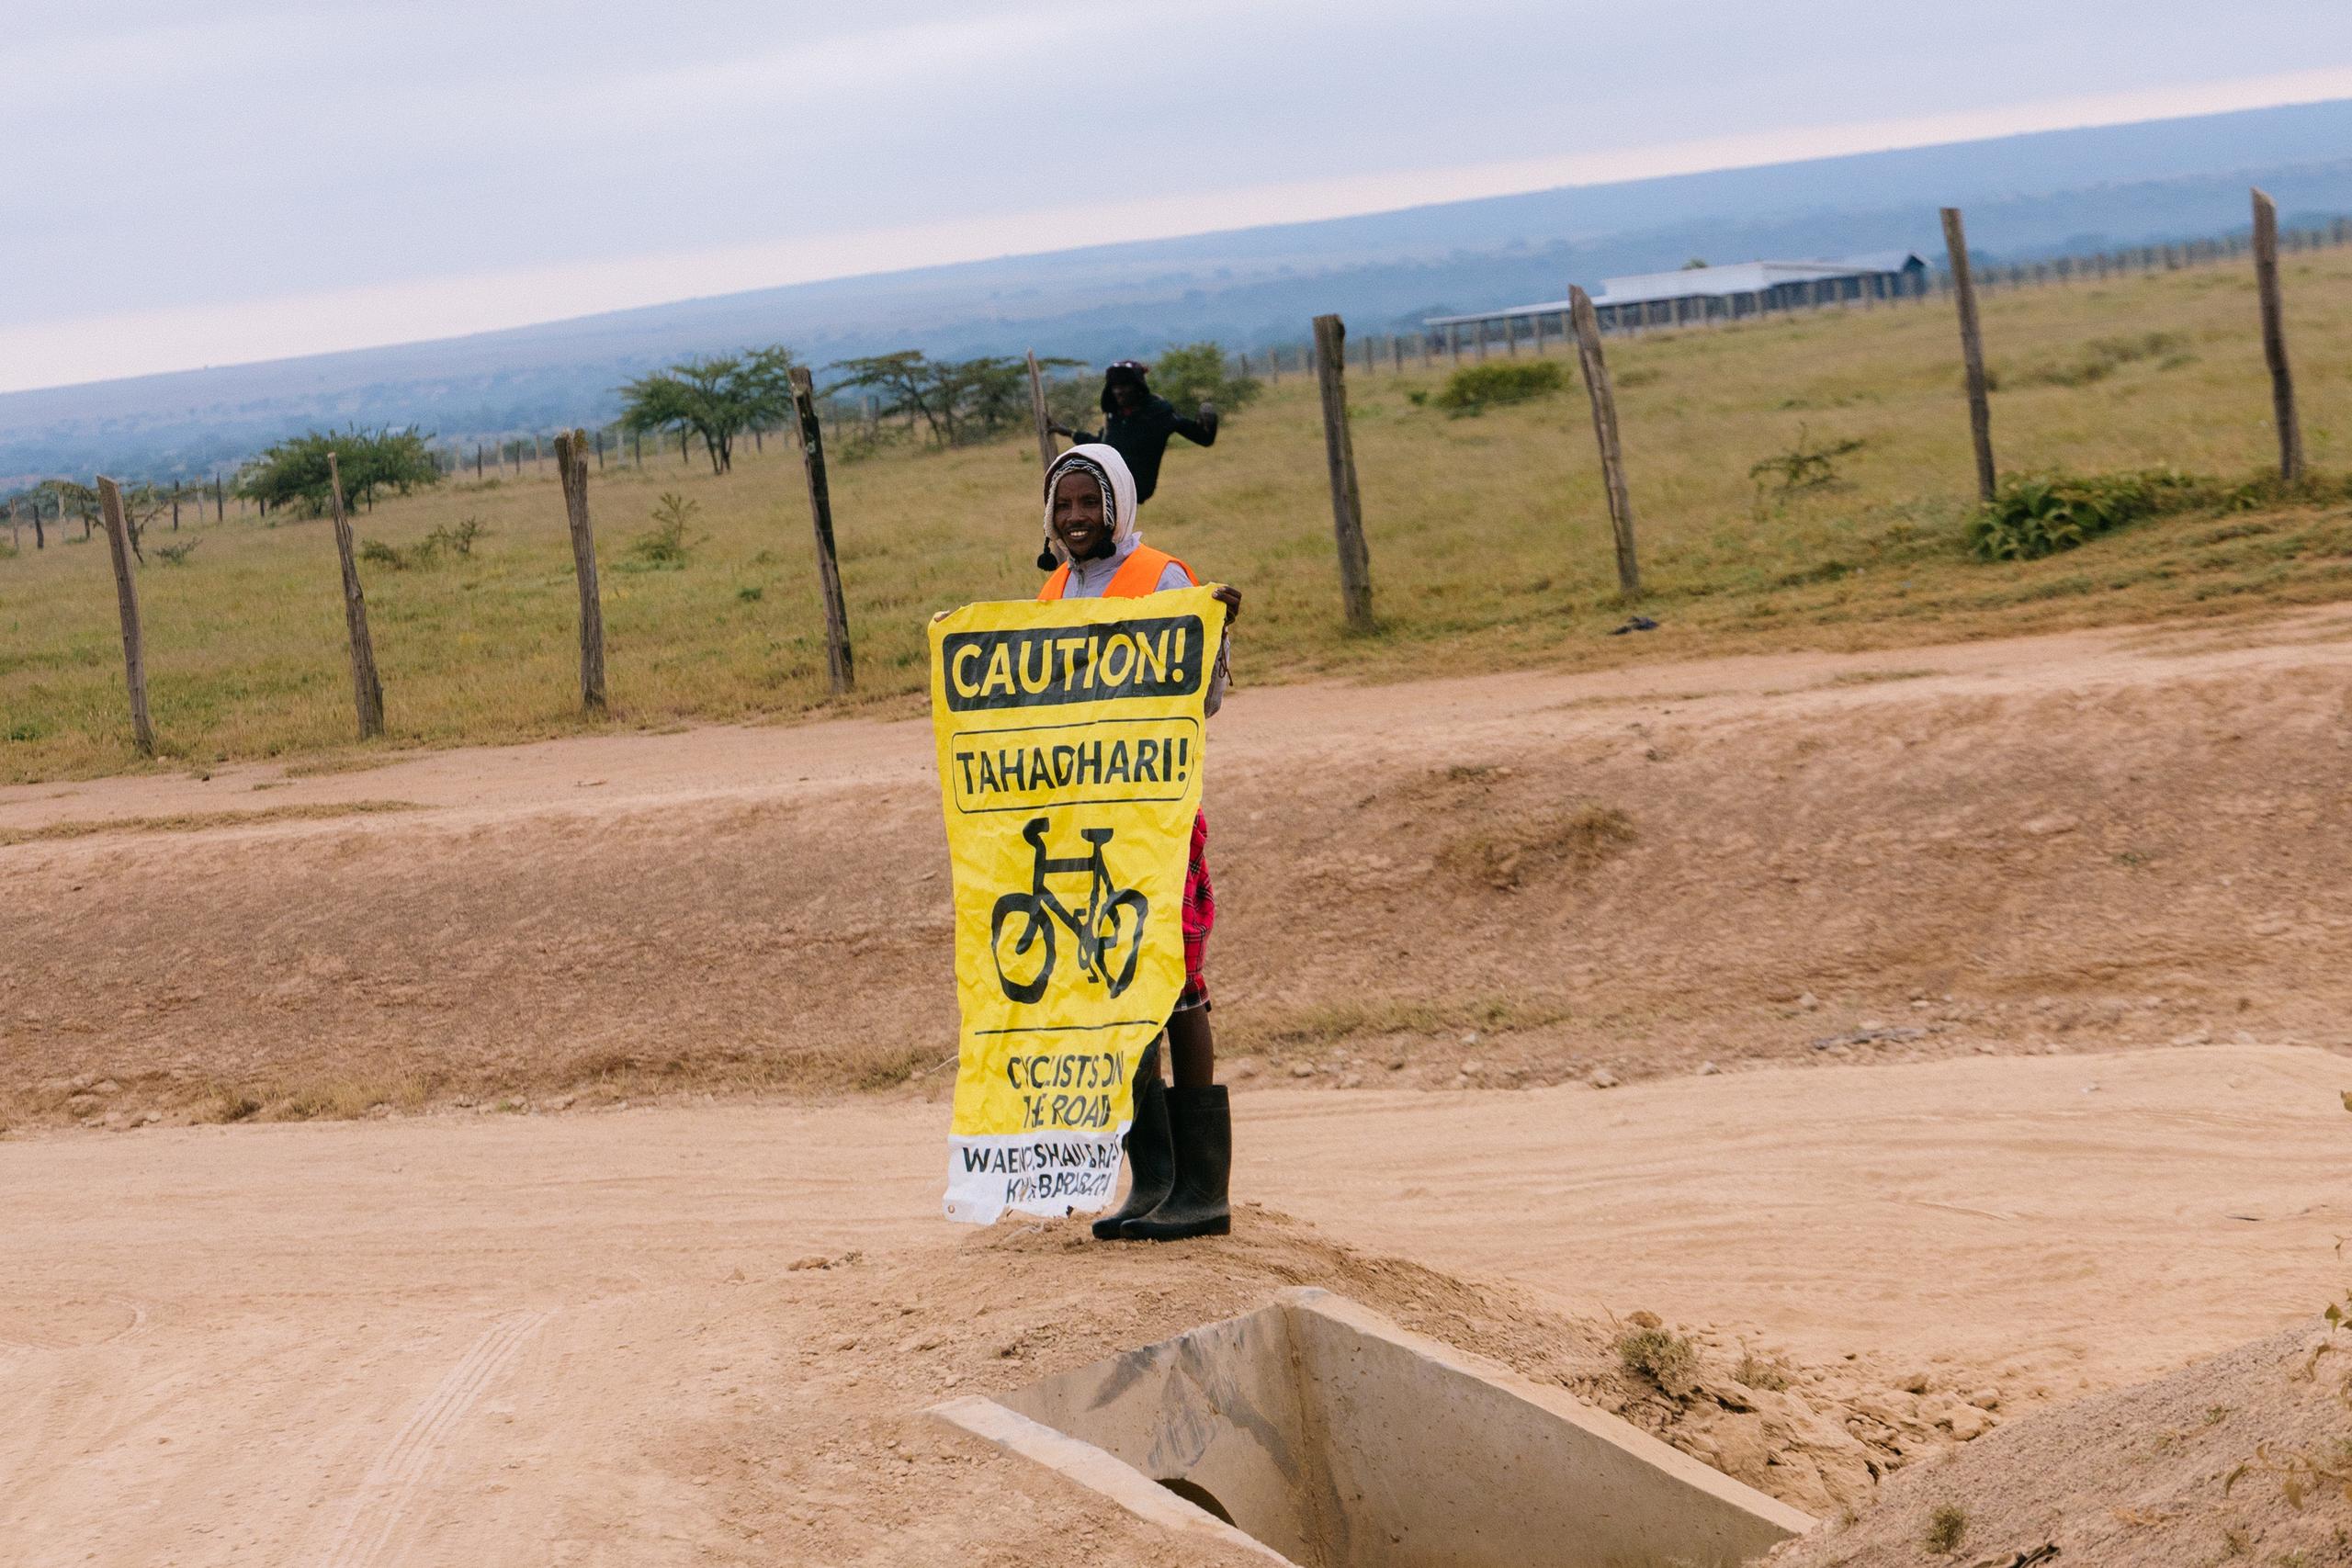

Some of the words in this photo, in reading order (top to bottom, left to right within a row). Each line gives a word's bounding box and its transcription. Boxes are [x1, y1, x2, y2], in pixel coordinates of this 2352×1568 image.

[952, 627, 1186, 698] CAUTION!
[956, 738, 1188, 795] TAHADHARI!
[1051, 1094, 1112, 1128] ROAD
[963, 1142, 1086, 1174] WAENDSHAJI
